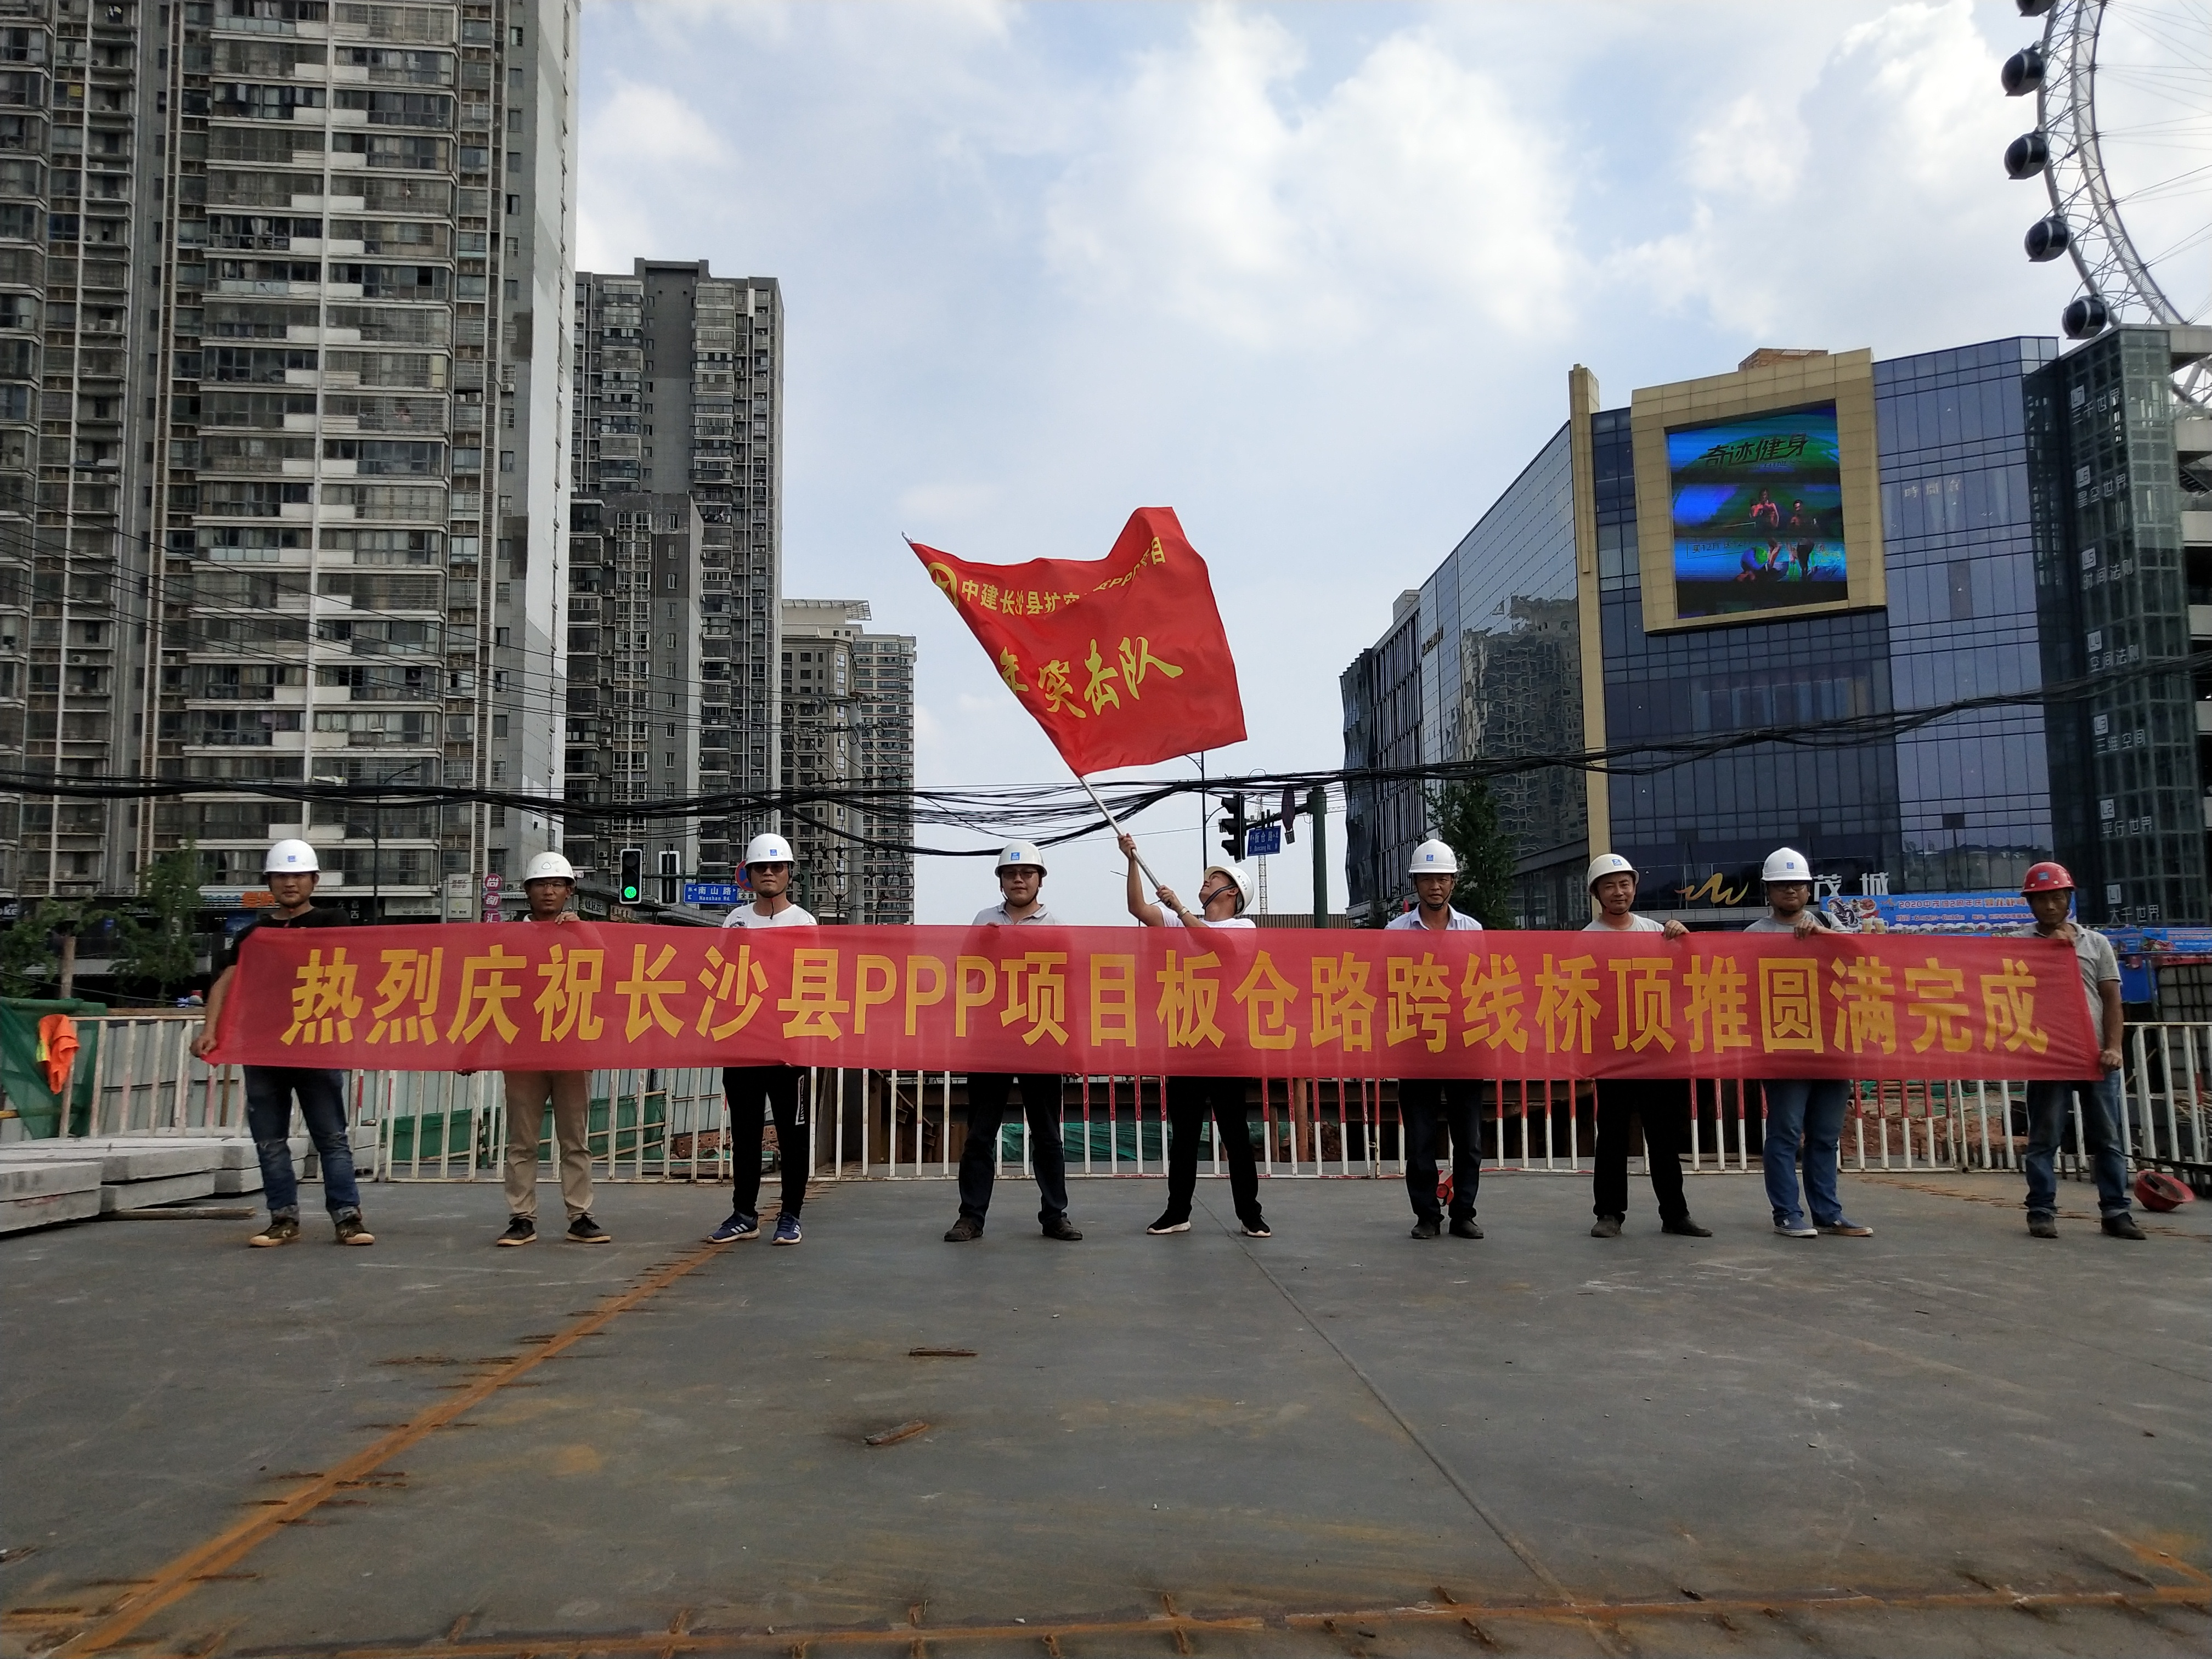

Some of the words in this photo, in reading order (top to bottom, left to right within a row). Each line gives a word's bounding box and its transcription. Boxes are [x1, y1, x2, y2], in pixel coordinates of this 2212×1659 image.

[2072, 387, 2120, 425] 三千世界
[1697, 433, 1809, 468] 奇迹健身
[2077, 473, 2126, 509] 星空世界
[2082, 550, 2096, 568] L5
[2083, 558, 2134, 590] 时间法则
[2089, 633, 2101, 651] L4
[2090, 644, 2139, 673] 空间法则
[2095, 716, 2107, 734] L3
[2096, 729, 2146, 754] 三维空间
[2101, 801, 2114, 818] L2
[2102, 816, 2152, 838] 平行世界
[486, 877, 500, 923] 尚都汇
[698, 887, 732, 895] 南山路
[2109, 905, 2160, 924] 大千世界
[280, 943, 2049, 1055] 热烈庆祝长沙县PPP项目板仓路跨线桥顶推圆满完成
